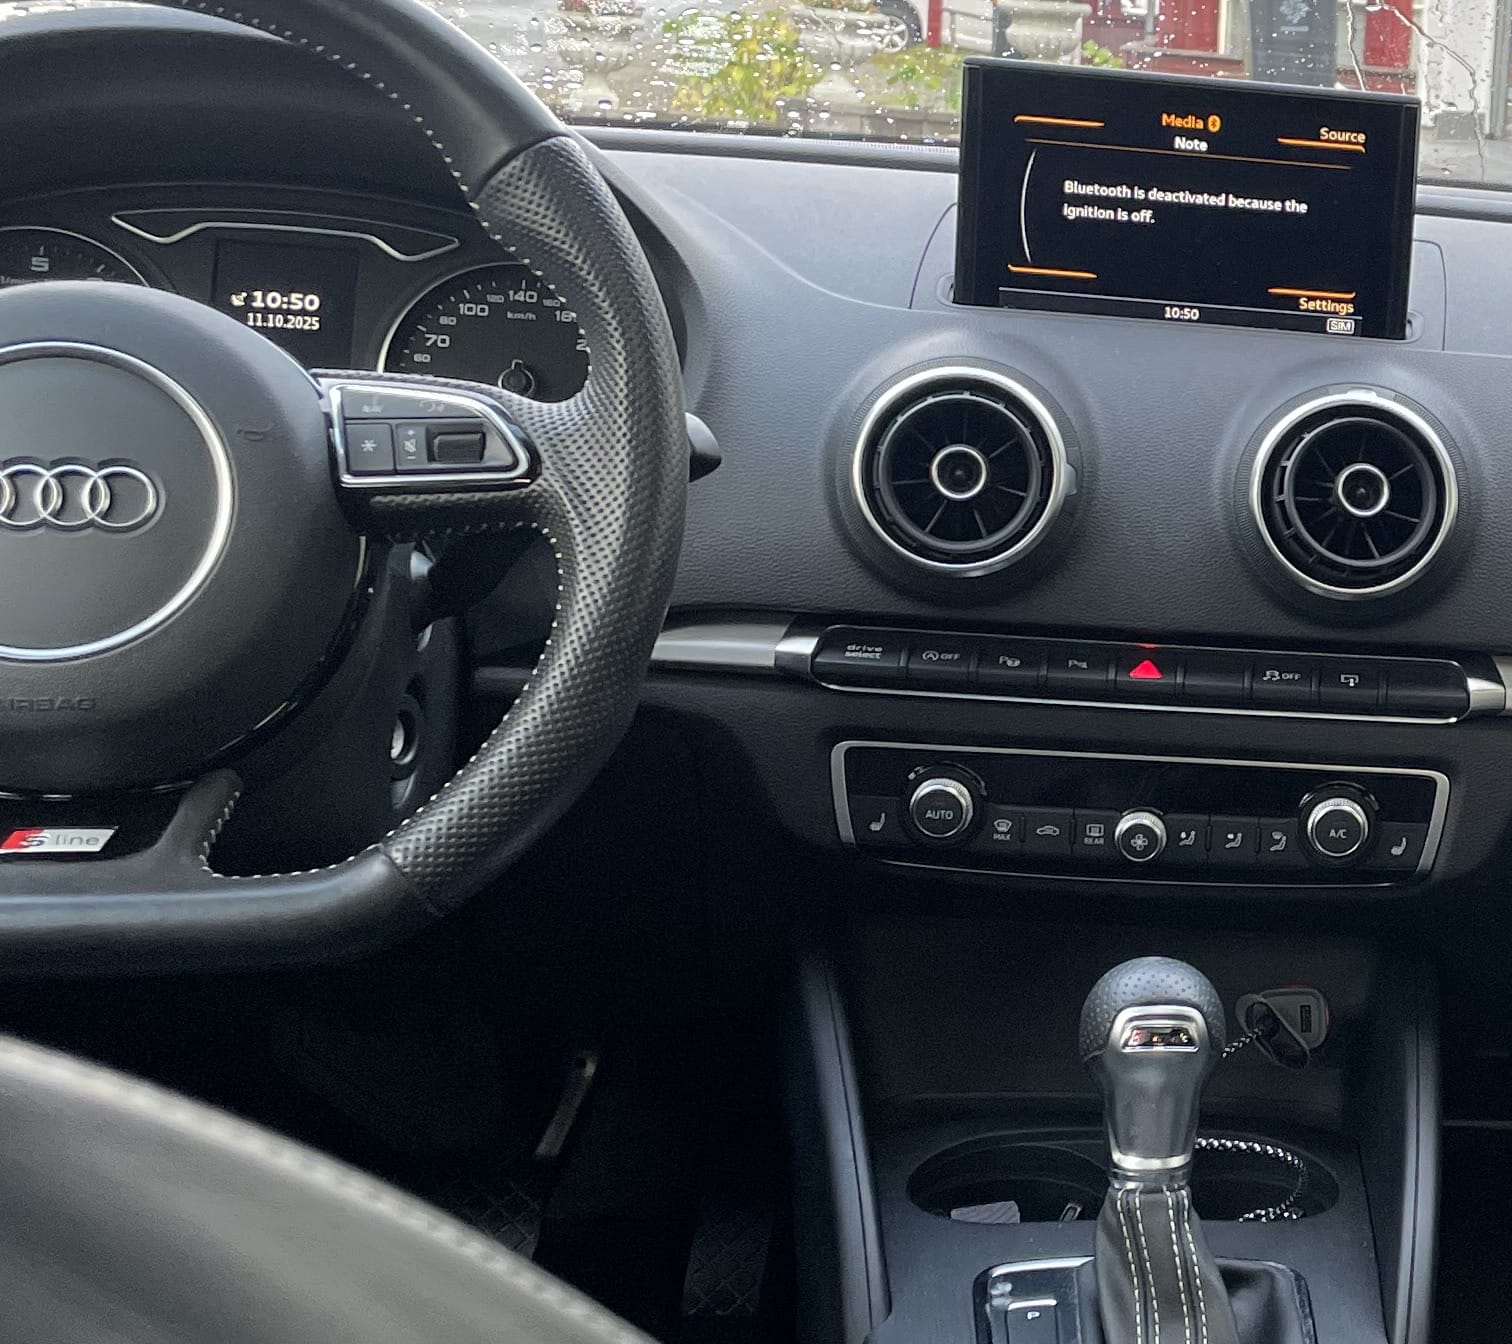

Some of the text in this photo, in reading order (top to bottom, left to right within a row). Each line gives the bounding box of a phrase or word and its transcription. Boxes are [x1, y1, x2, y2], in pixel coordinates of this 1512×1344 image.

[1161, 112, 1204, 130] Media
[1319, 126, 1366, 144] Source
[1173, 135, 1208, 152] Note
[1063, 179, 1308, 214] Bluetooth is deactivated because the
[1062, 203, 1156, 224] ignition is off.
[31, 256, 50, 273] 5
[251, 290, 320, 311] 10:50
[486, 294, 505, 304] 120
[508, 289, 538, 303] 140
[458, 303, 489, 316] 100
[1299, 297, 1355, 316] Settings
[506, 311, 537, 321] km/h
[1164, 305, 1200, 322] 10:50
[247, 312, 320, 331] 11.10.2025
[438, 315, 457, 326] 80
[1330, 320, 1352, 332] SIM
[424, 333, 450, 348] 70
[413, 353, 431, 363] 60
[846, 644, 883, 653] drive
[844, 651, 881, 659] select
[940, 653, 960, 661] OFF
[1281, 672, 1301, 681] OFF
[925, 809, 954, 821] AUTO
[993, 833, 1012, 842] MAX
[1328, 828, 1348, 839] A/C
[55, 834, 100, 846] line
[1083, 837, 1105, 846] REAR
[1027, 1311, 1040, 1320] P
